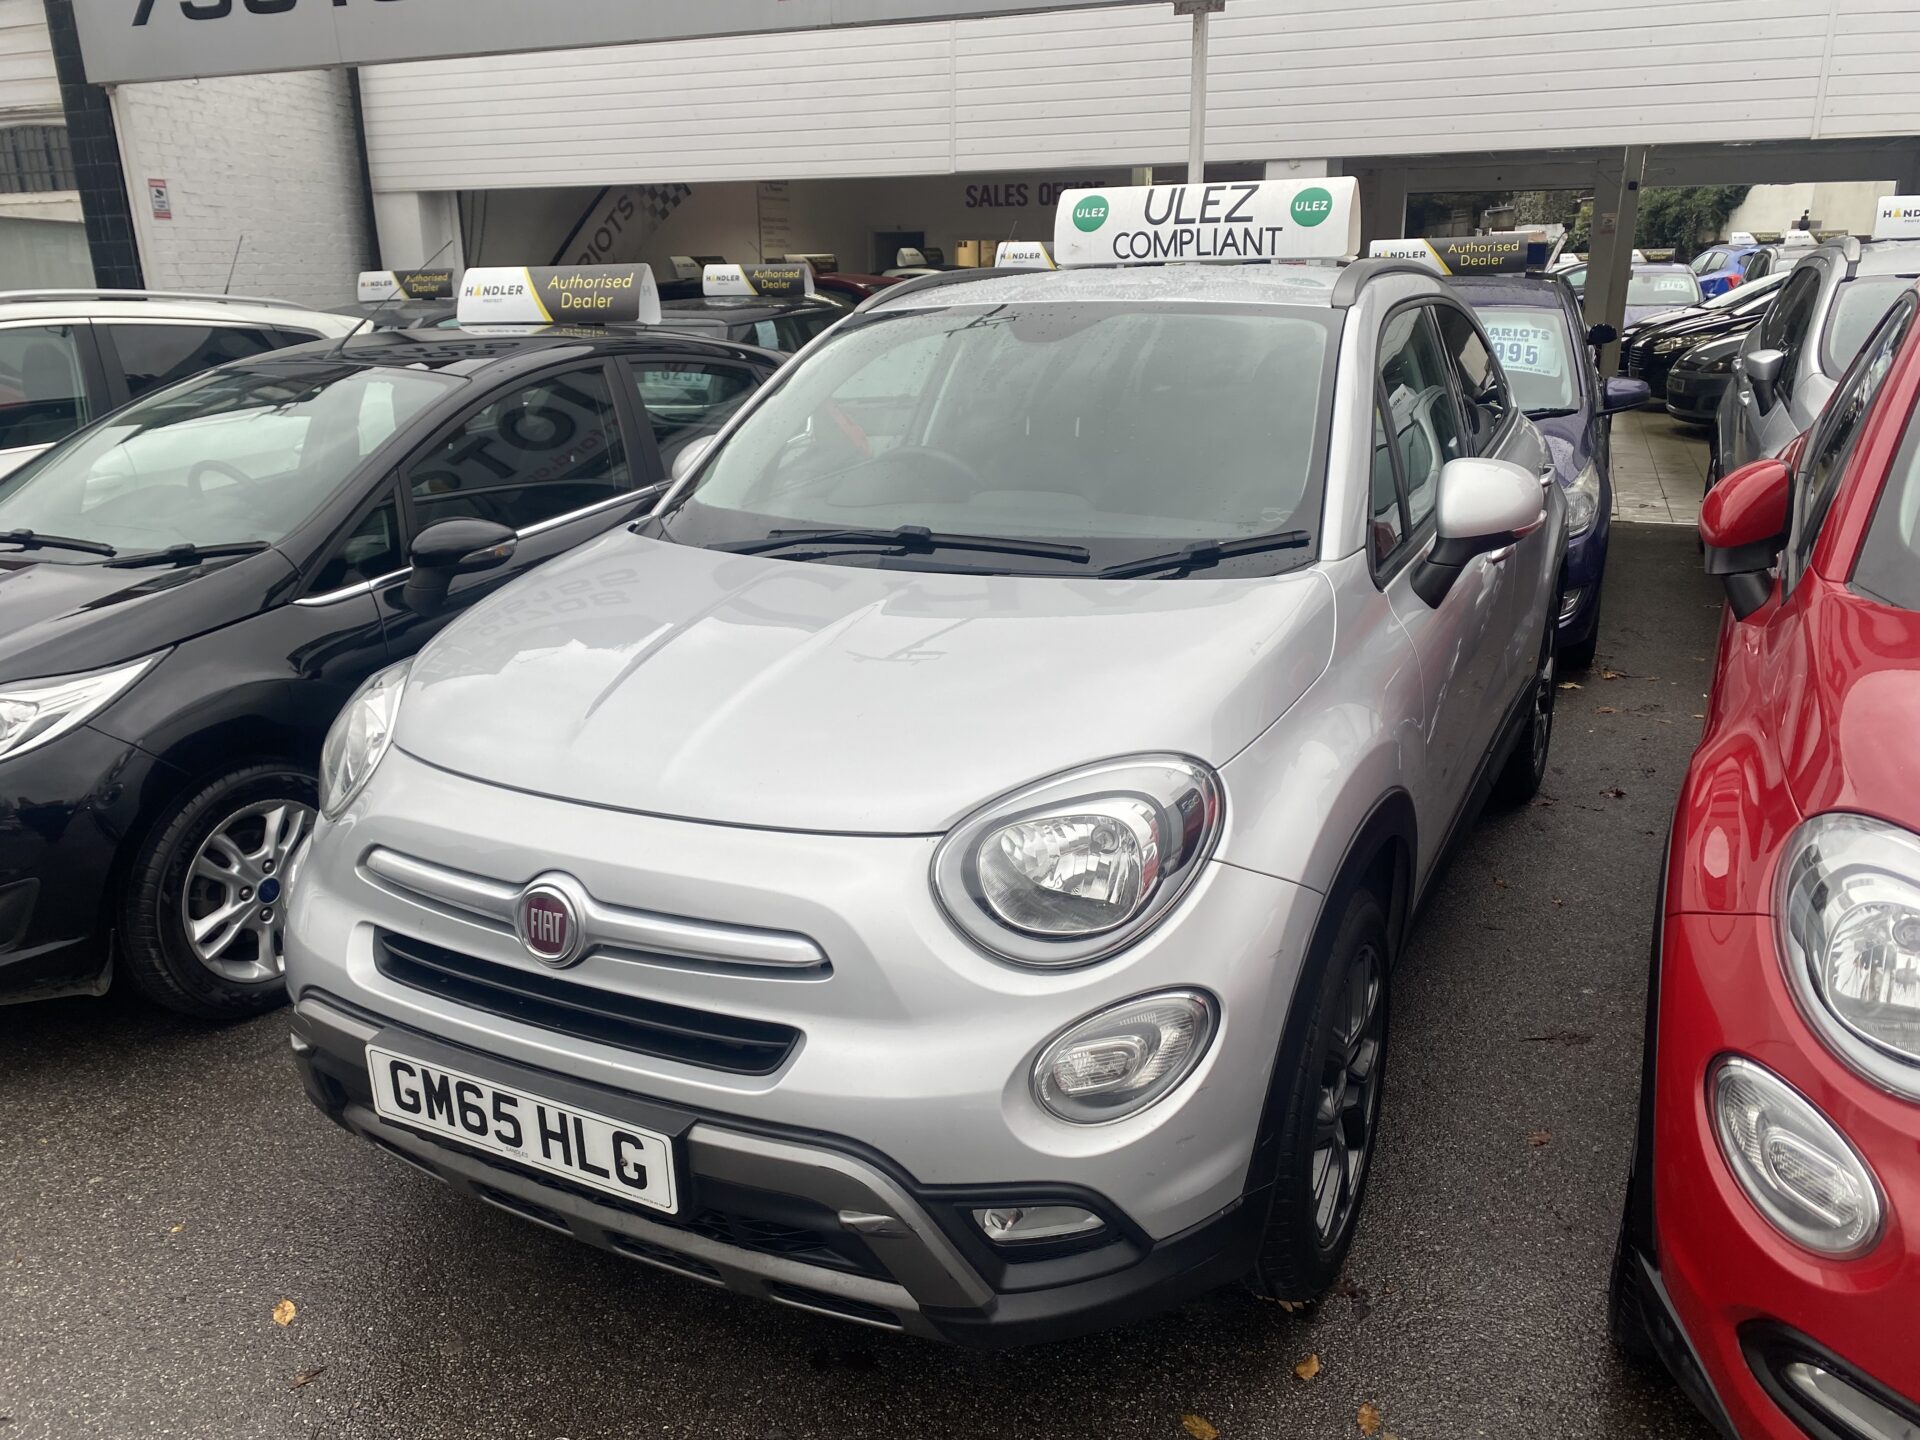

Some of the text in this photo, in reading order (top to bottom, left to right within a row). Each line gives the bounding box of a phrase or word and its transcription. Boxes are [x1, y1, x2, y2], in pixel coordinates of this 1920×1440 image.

[966, 183, 1028, 208] SALES
[1077, 207, 1105, 218] ULEZ
[1144, 185, 1260, 225] ULEZ
[1295, 201, 1328, 212] ULEZ
[1113, 227, 1283, 260] COMPLIANT
[1447, 240, 1520, 254] Authorised
[1461, 255, 1504, 266] Dealer
[548, 272, 635, 289] Authorised
[753, 269, 800, 279] Authorised
[412, 283, 439, 292] Dealer
[761, 279, 791, 289] Dealer
[561, 292, 614, 309] Dealer
[530, 907, 564, 943] FIAT
[389, 1059, 648, 1190] GM65 HLG
